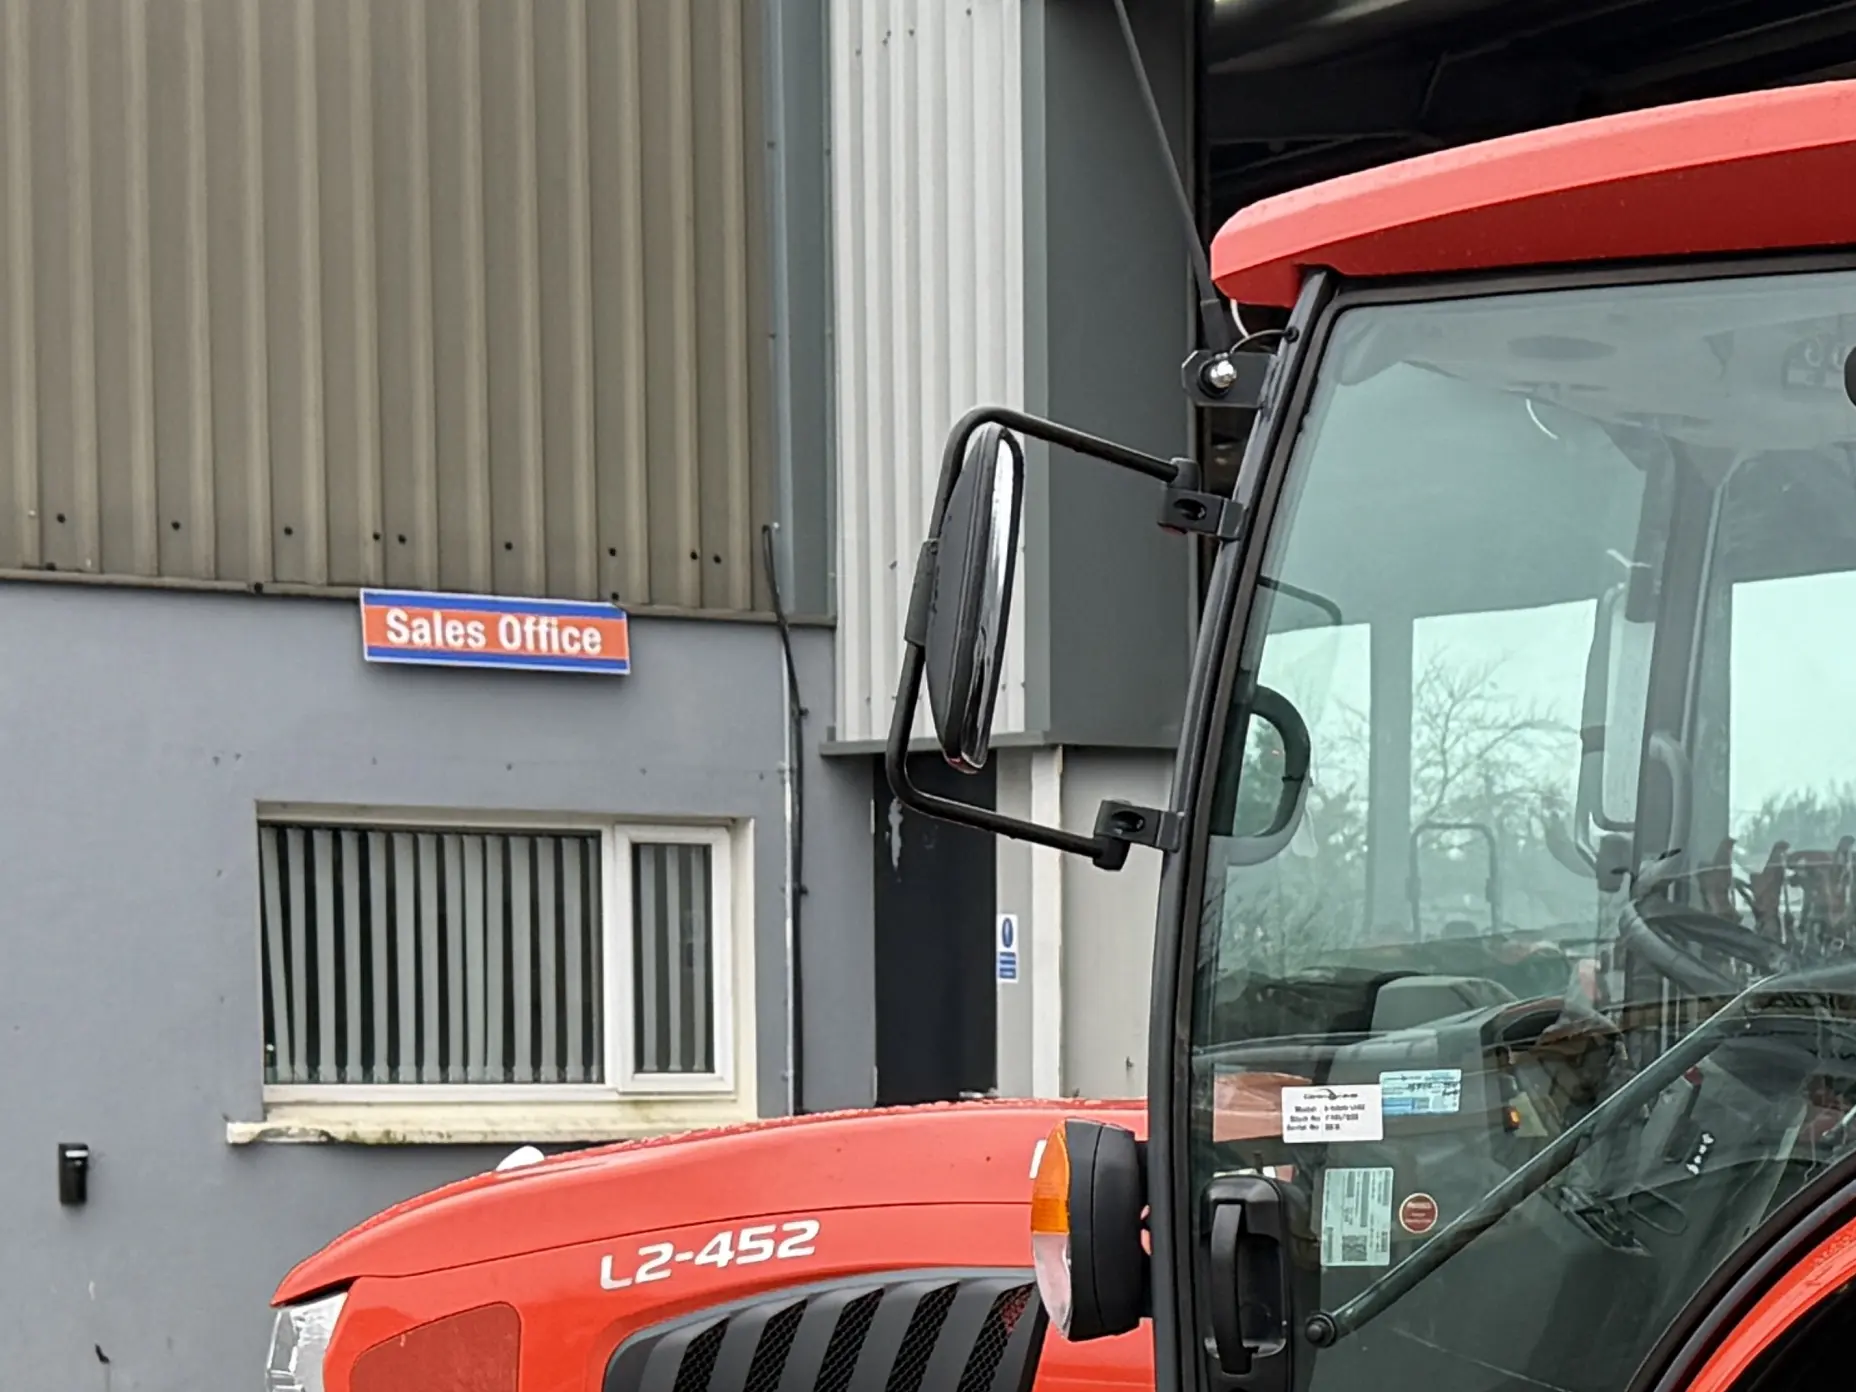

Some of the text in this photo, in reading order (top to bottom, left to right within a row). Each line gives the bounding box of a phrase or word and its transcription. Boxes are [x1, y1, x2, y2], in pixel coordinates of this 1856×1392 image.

[386, 608, 602, 655] Sales Office
[600, 1219, 820, 1291] L2-452
